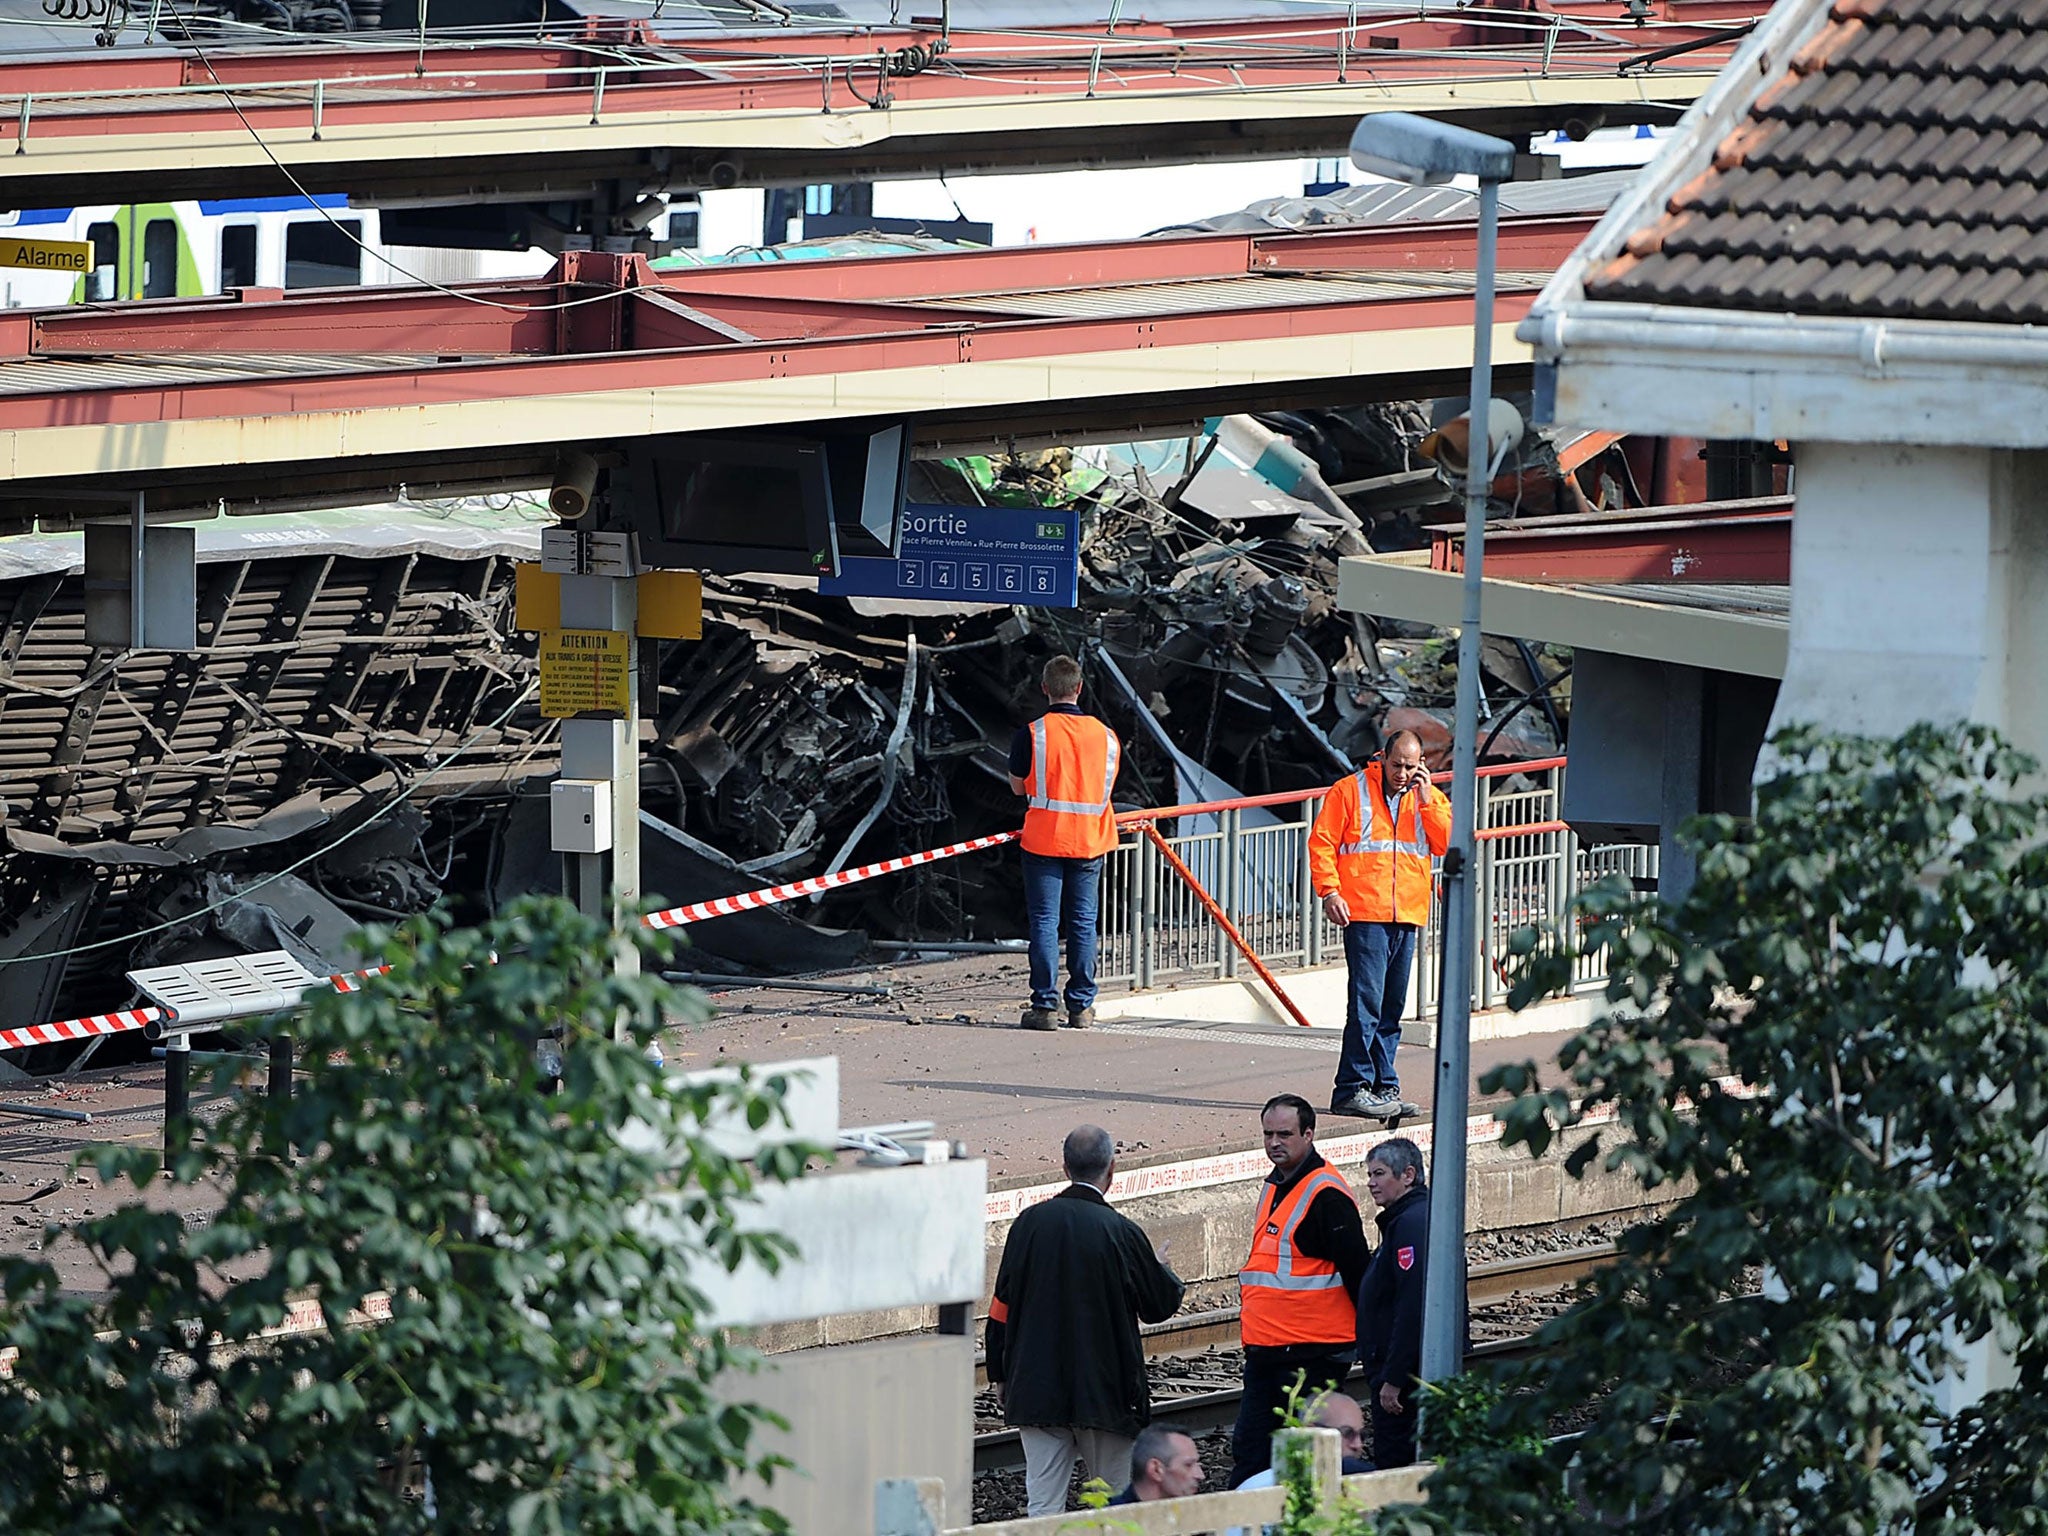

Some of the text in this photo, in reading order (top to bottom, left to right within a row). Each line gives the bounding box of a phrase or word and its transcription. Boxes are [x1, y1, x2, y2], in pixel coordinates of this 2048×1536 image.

[15, 246, 86, 268] Alarme
[902, 511, 968, 534] Sortie
[901, 535, 1065, 552] lace Pierre Vennin Rue Pierre Brossolette
[906, 570, 915, 584] 2
[939, 572, 949, 586] 4
[972, 573, 981, 587] 5
[1005, 575, 1015, 589] 6
[1038, 577, 1047, 591] 8
[561, 634, 608, 649] ATTENTION
[1150, 1168, 1177, 1189] DANGER
